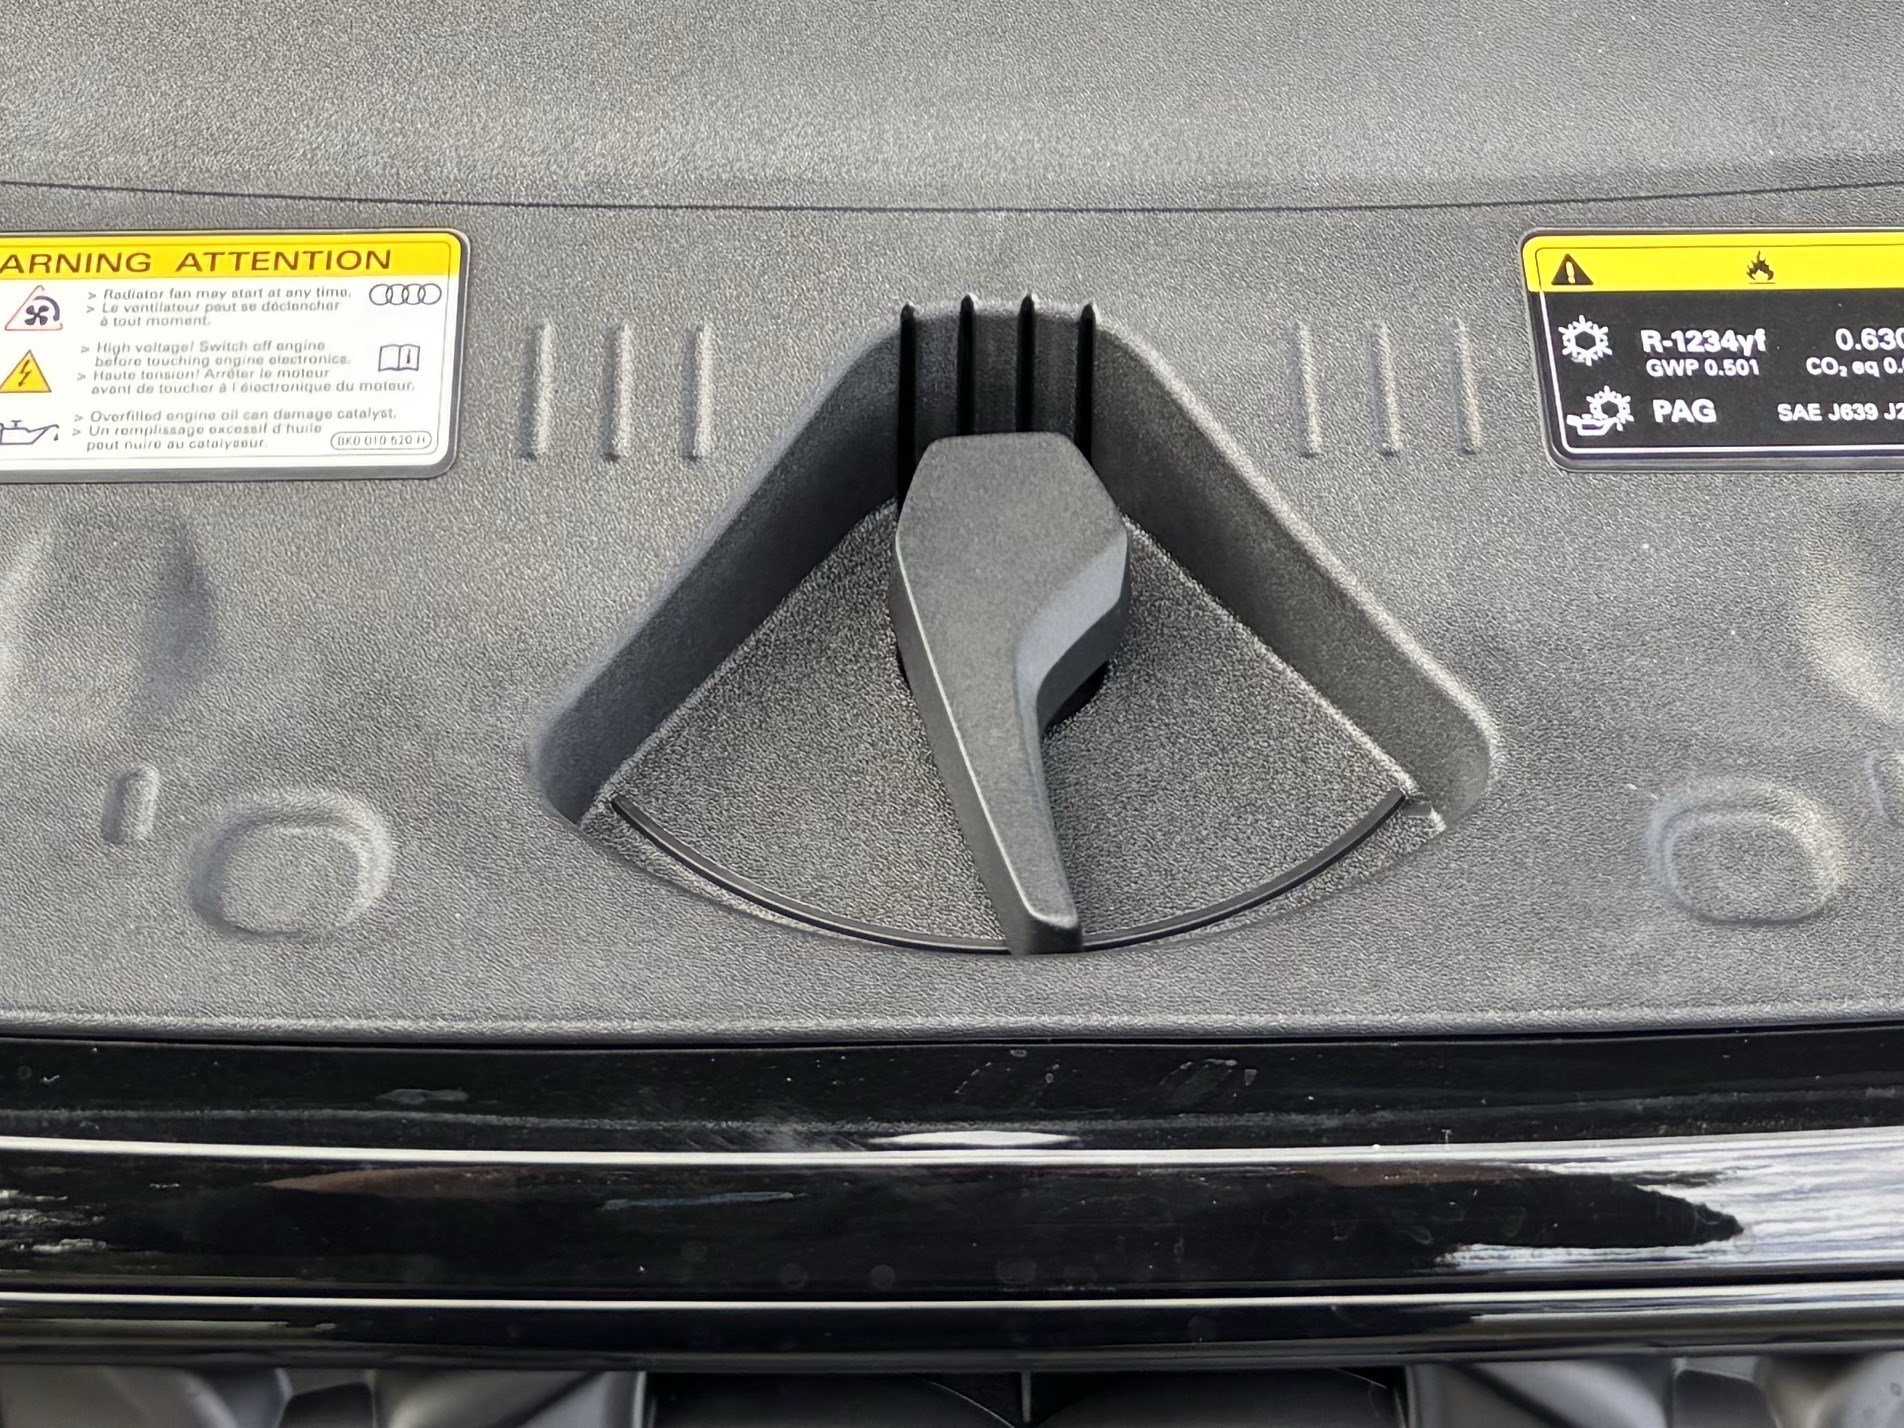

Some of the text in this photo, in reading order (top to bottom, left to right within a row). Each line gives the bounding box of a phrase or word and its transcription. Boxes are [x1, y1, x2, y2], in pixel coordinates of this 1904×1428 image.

[176, 247, 393, 273] ATTENTION
[103, 287, 164, 300] Radiator
[169, 287, 192, 300] fan
[196, 288, 225, 302] may
[231, 287, 263, 299] start
[267, 287, 282, 298] at
[286, 288, 312, 301] any
[101, 302, 119, 314] Le
[124, 300, 201, 313] ventilateur
[204, 301, 237, 316] peut
[113, 315, 142, 327] tout
[96, 340, 131, 357] High
[199, 340, 248, 353] Switch
[253, 339, 272, 352] off
[277, 340, 326, 354] engine
[1640, 326, 1768, 356] R-1234yf
[95, 354, 143, 367] before
[146, 354, 210, 369] touching
[214, 355, 264, 369] engine
[1645, 357, 1760, 378] GWP 0.501
[1851, 360, 1881, 378] eq
[93, 369, 137, 381] Haute
[259, 367, 272, 379] le
[277, 367, 330, 379] moteur
[91, 382, 131, 395] avant
[136, 382, 155, 394] de
[159, 381, 213, 394] toucher
[336, 380, 355, 392] du
[90, 410, 162, 423] Overfilled
[166, 410, 216, 425] engine
[221, 409, 239, 421] oil
[243, 410, 269, 421] can
[273, 408, 333, 423] damage
[1652, 398, 1718, 425] PAG
[1777, 402, 1823, 422] SAE
[1827, 402, 1879, 421] J639
[88, 425, 110, 437] Un
